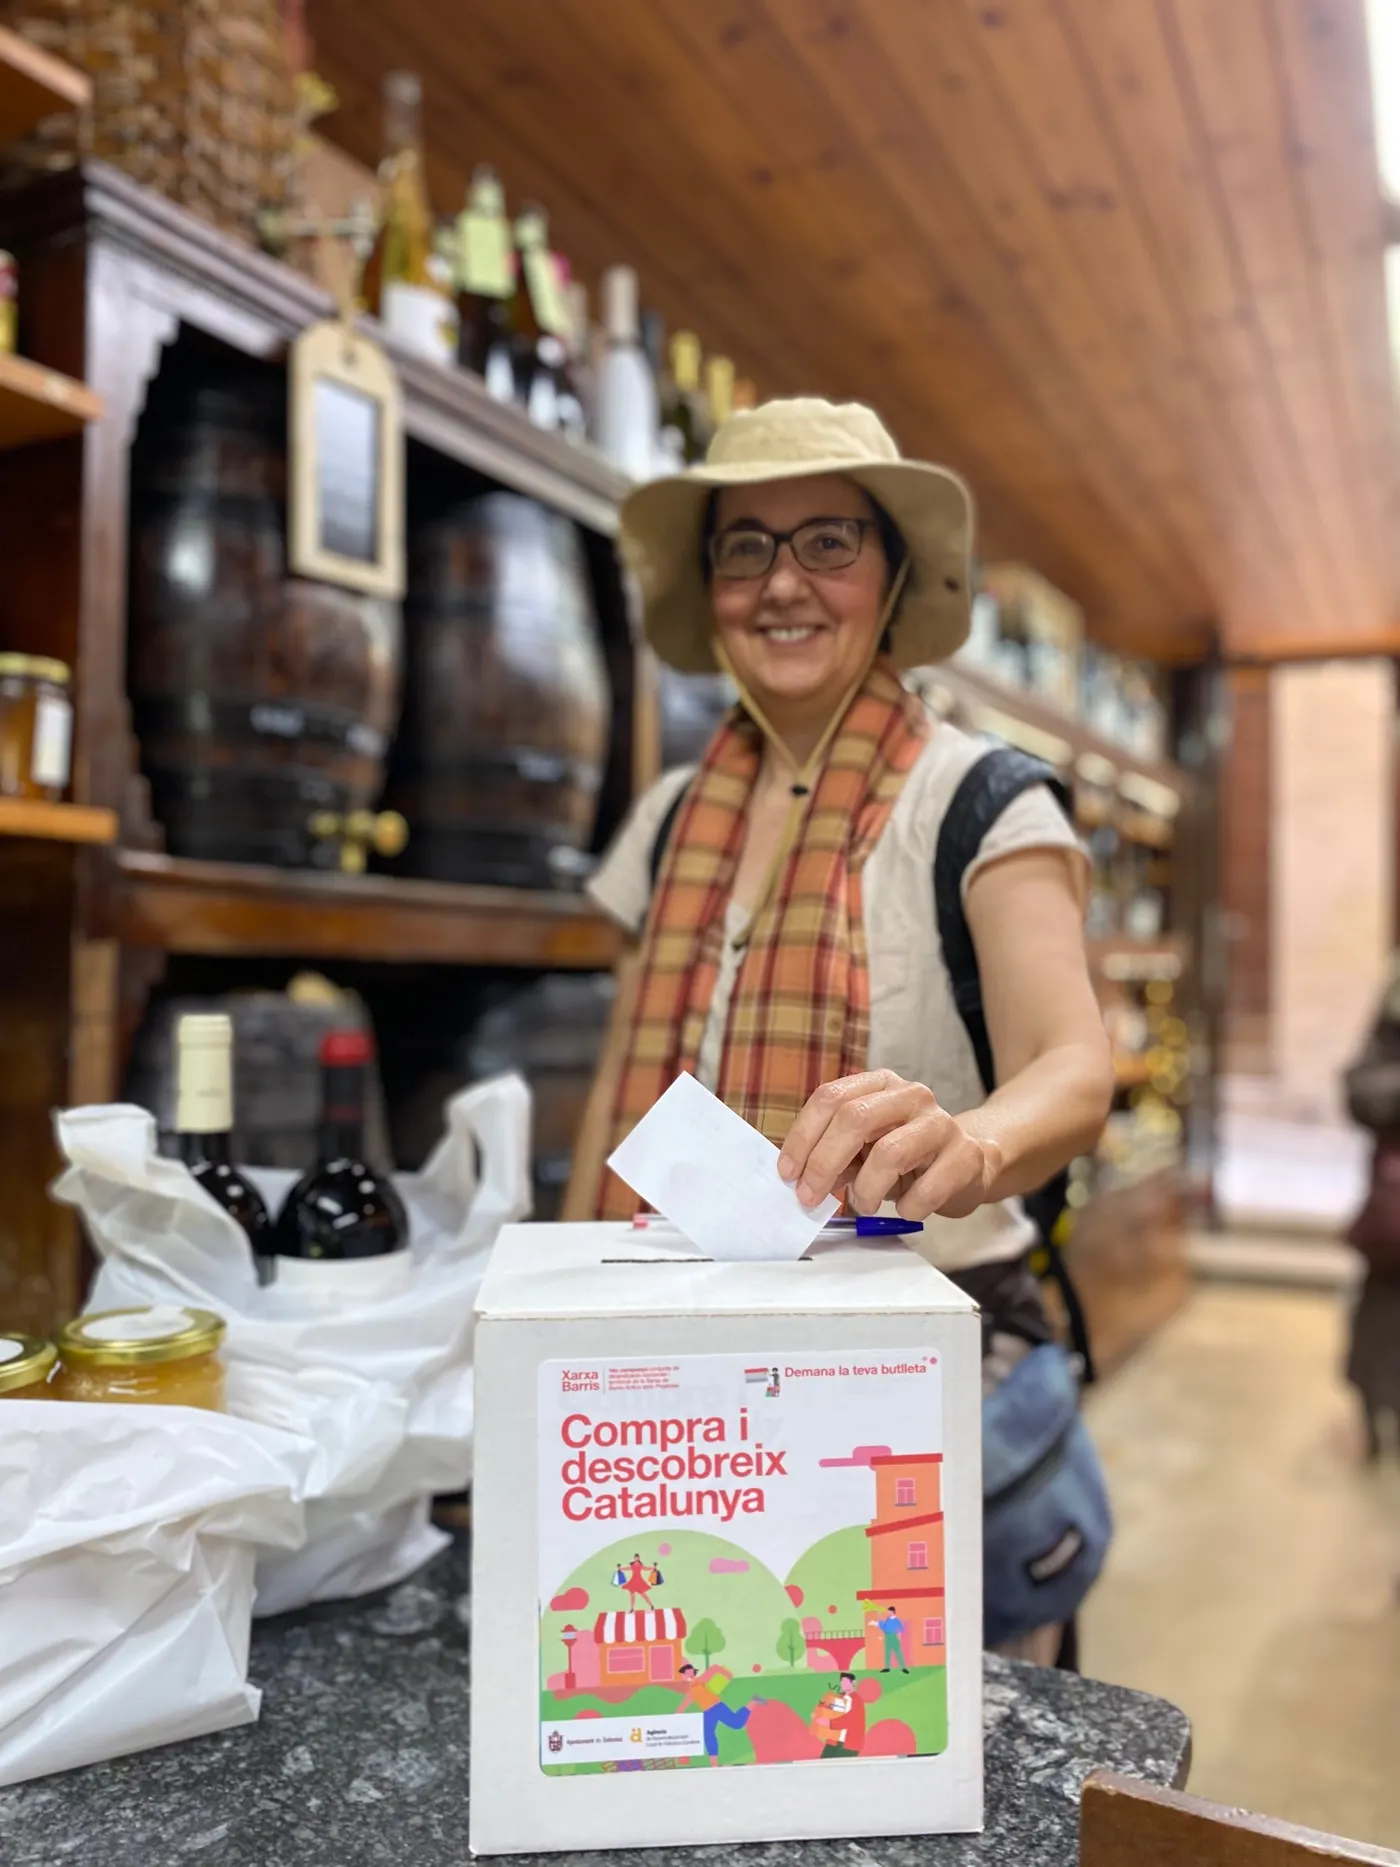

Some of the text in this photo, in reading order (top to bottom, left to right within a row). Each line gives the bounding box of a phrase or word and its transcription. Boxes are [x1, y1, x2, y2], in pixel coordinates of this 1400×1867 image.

[561, 1370, 599, 1380] Xarxa
[785, 1363, 927, 1378] Demana la teva butlleta
[561, 1380, 600, 1392] Barris
[561, 1407, 748, 1452] Compra i
[561, 1443, 788, 1485] descobreix
[562, 1483, 765, 1522] Catalunya
